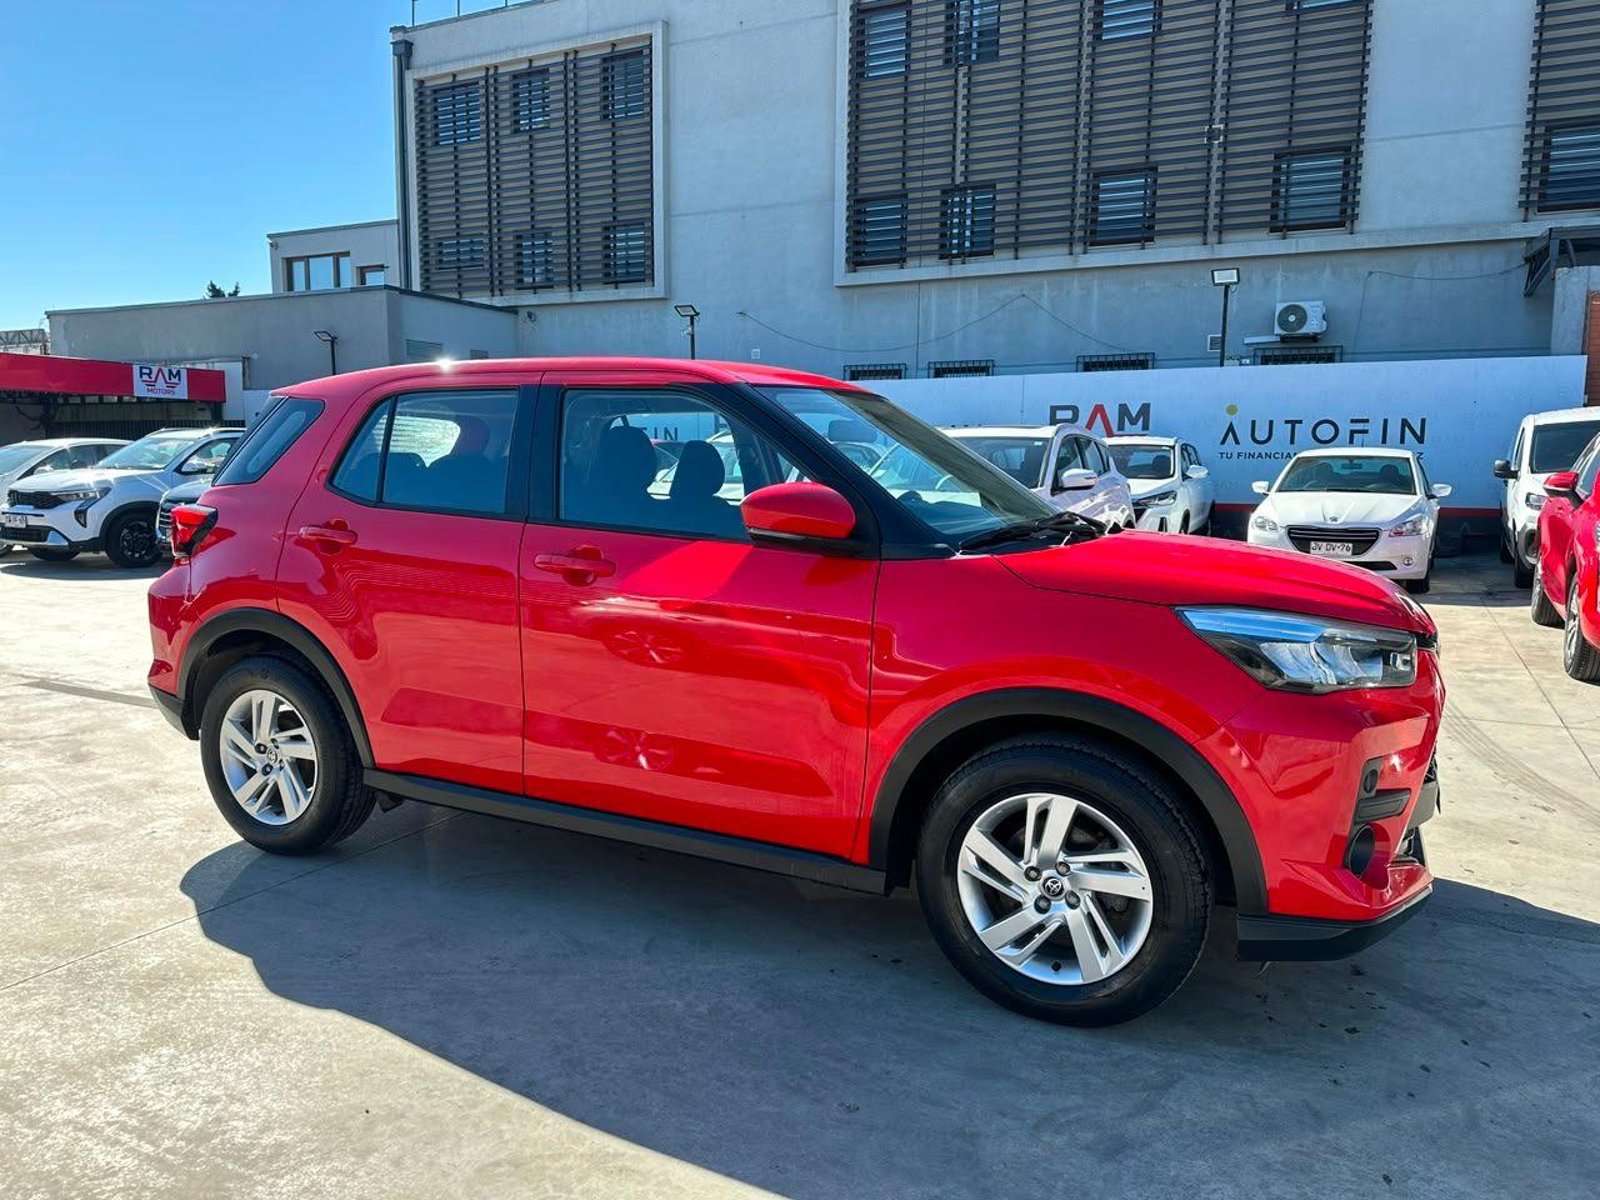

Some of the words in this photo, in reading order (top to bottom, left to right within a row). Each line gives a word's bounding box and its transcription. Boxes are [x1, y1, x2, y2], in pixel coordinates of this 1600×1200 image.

[139, 366, 181, 382] RAM
[1219, 416, 1427, 446] AUTOFIN
[1219, 451, 1233, 460] TU
[1237, 451, 1297, 460] FINANCIA
